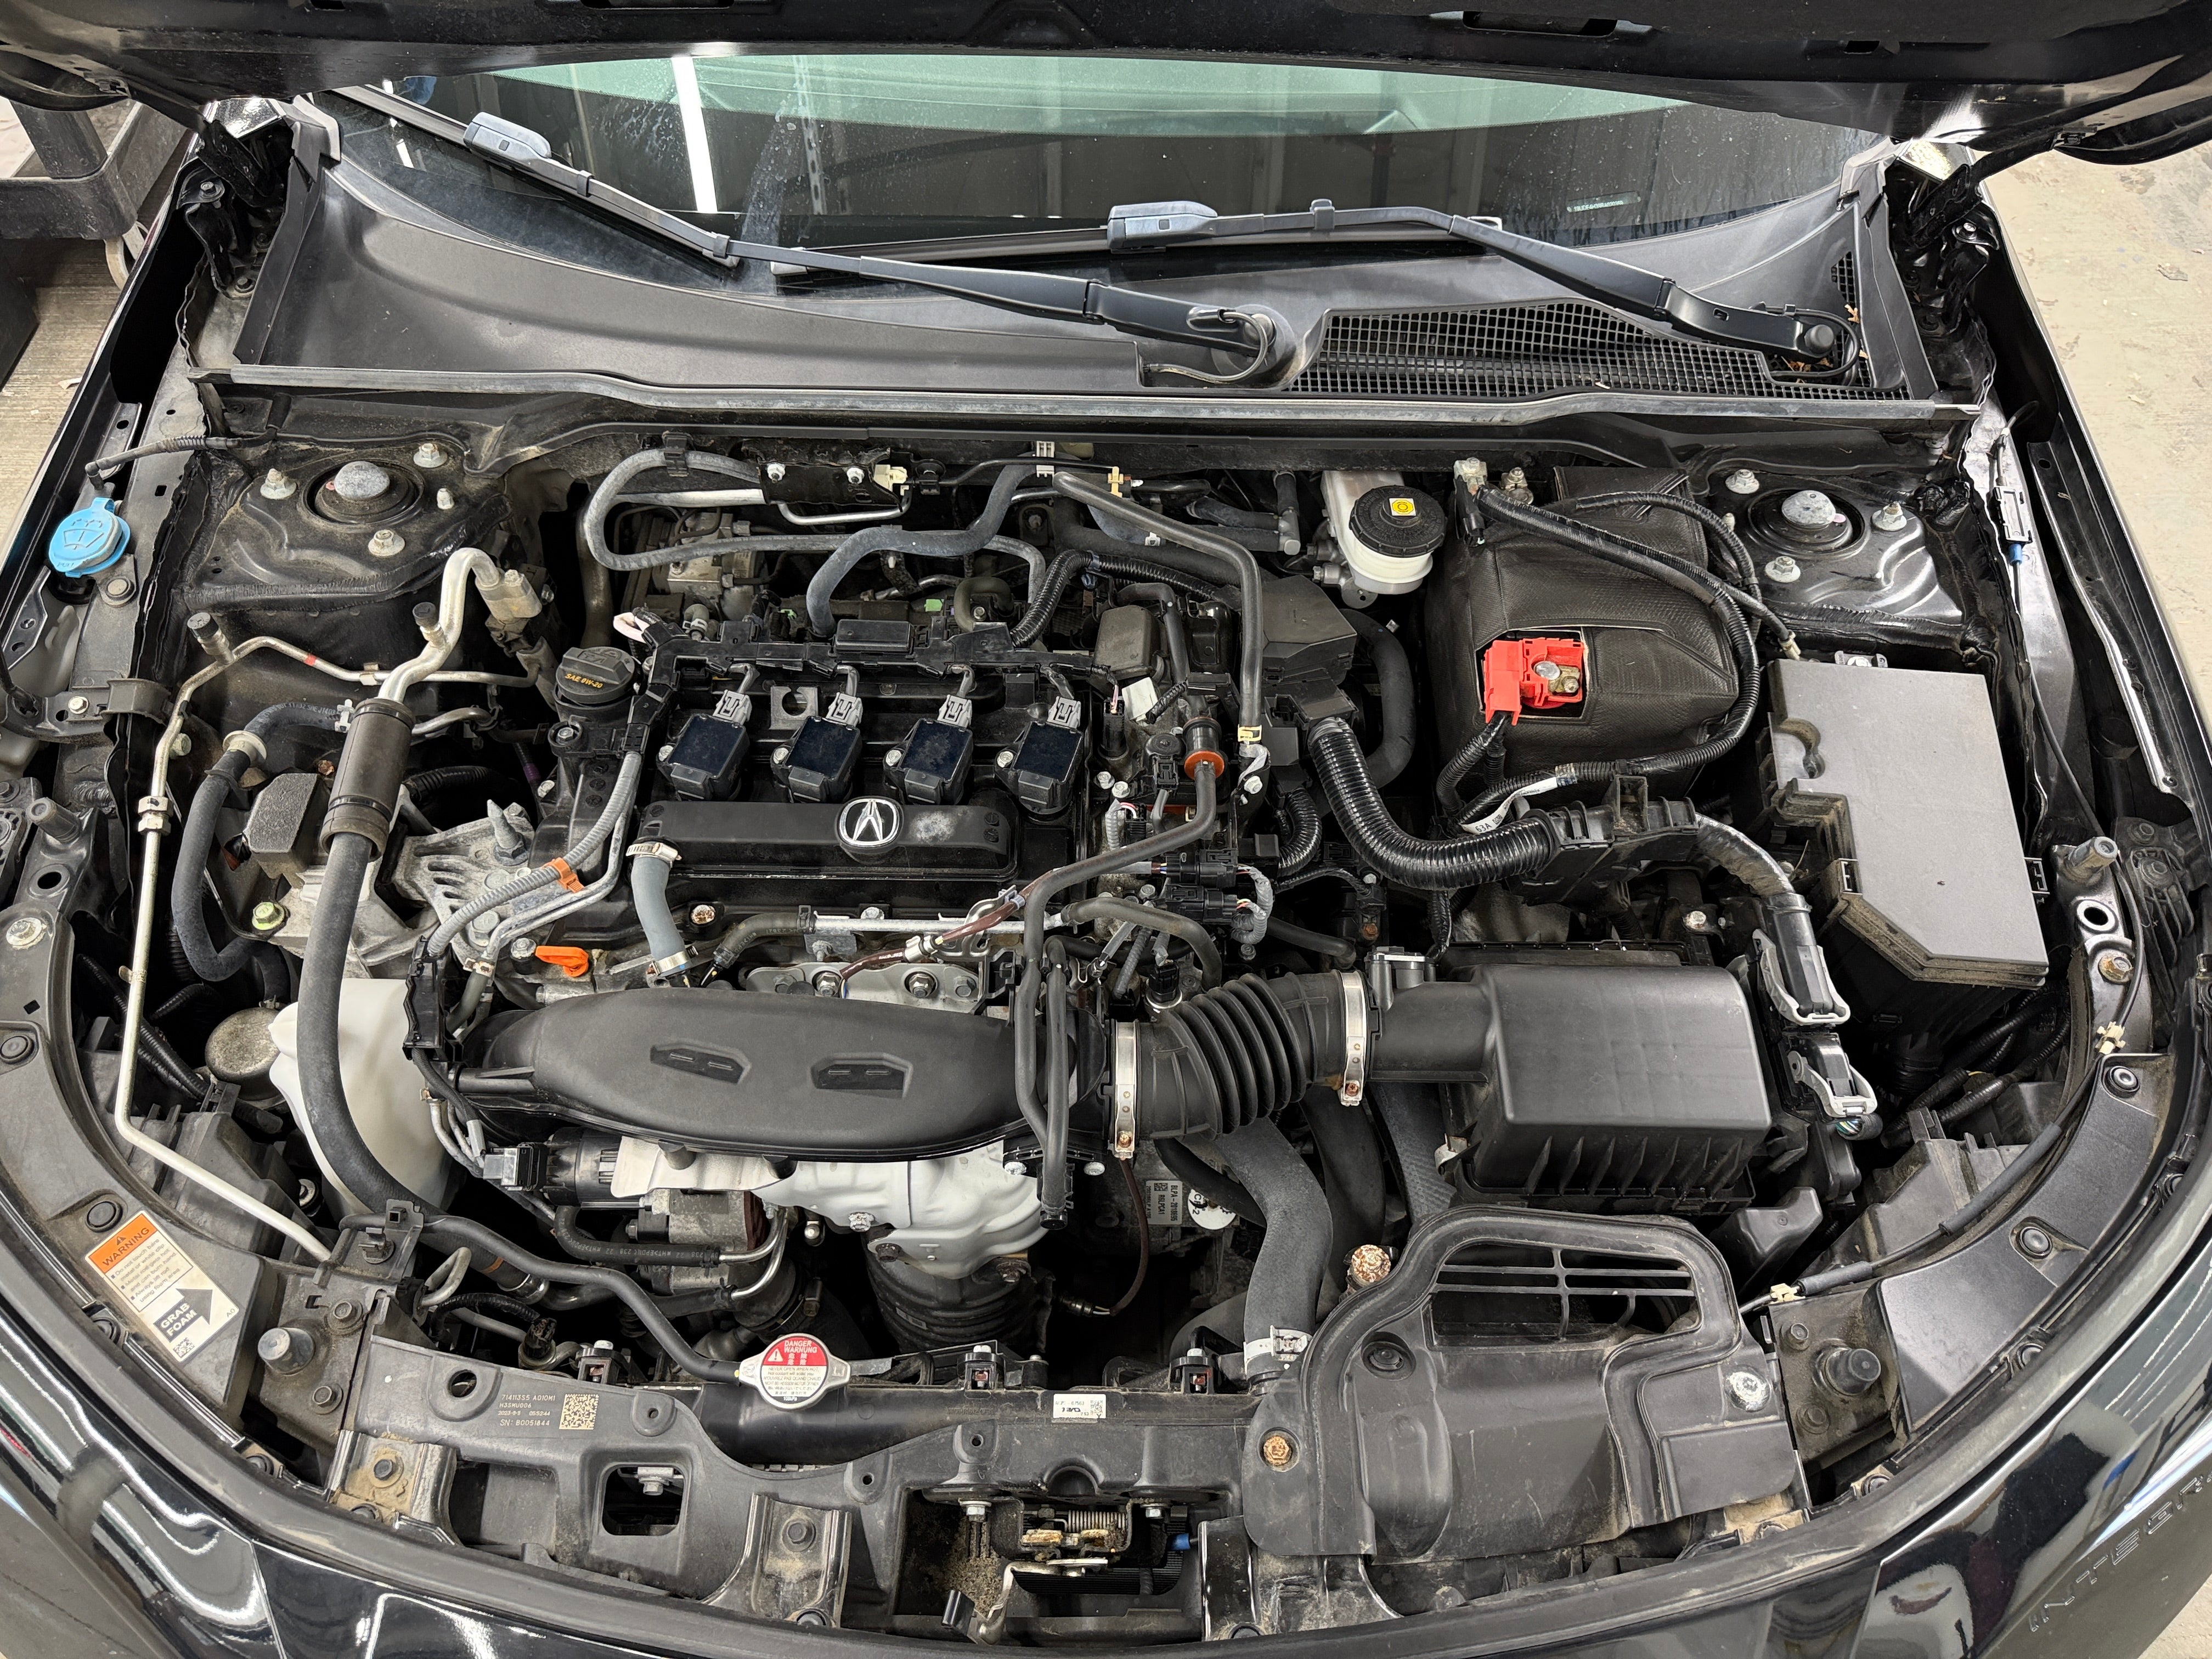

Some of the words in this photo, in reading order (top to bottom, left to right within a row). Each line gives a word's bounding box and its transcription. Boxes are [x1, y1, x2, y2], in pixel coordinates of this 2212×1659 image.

[565, 673, 582, 682] SAE
[580, 678, 603, 689] 0W-20
[1475, 823, 1493, 832] 63A
[102, 1227, 150, 1266] WARNING
[115, 1268, 124, 1276] Do
[124, 1261, 133, 1269] not
[132, 1249, 148, 1262] touch
[146, 1239, 160, 1250] bare
[120, 1269, 136, 1282] metal
[140, 1251, 156, 1263] white
[130, 1282, 142, 1292] and
[141, 1274, 151, 1283] can
[151, 1263, 163, 1274] burn
[125, 1274, 140, 1287] Metal
[135, 1281, 154, 1297] Always
[160, 1267, 170, 1276] rod
[139, 1290, 155, 1302] using
[154, 1279, 168, 1290] foam
[161, 1302, 190, 1328] GRAB
[166, 1310, 198, 1336] FOAM
[2029, 1468, 2212, 1633] INTEGR
